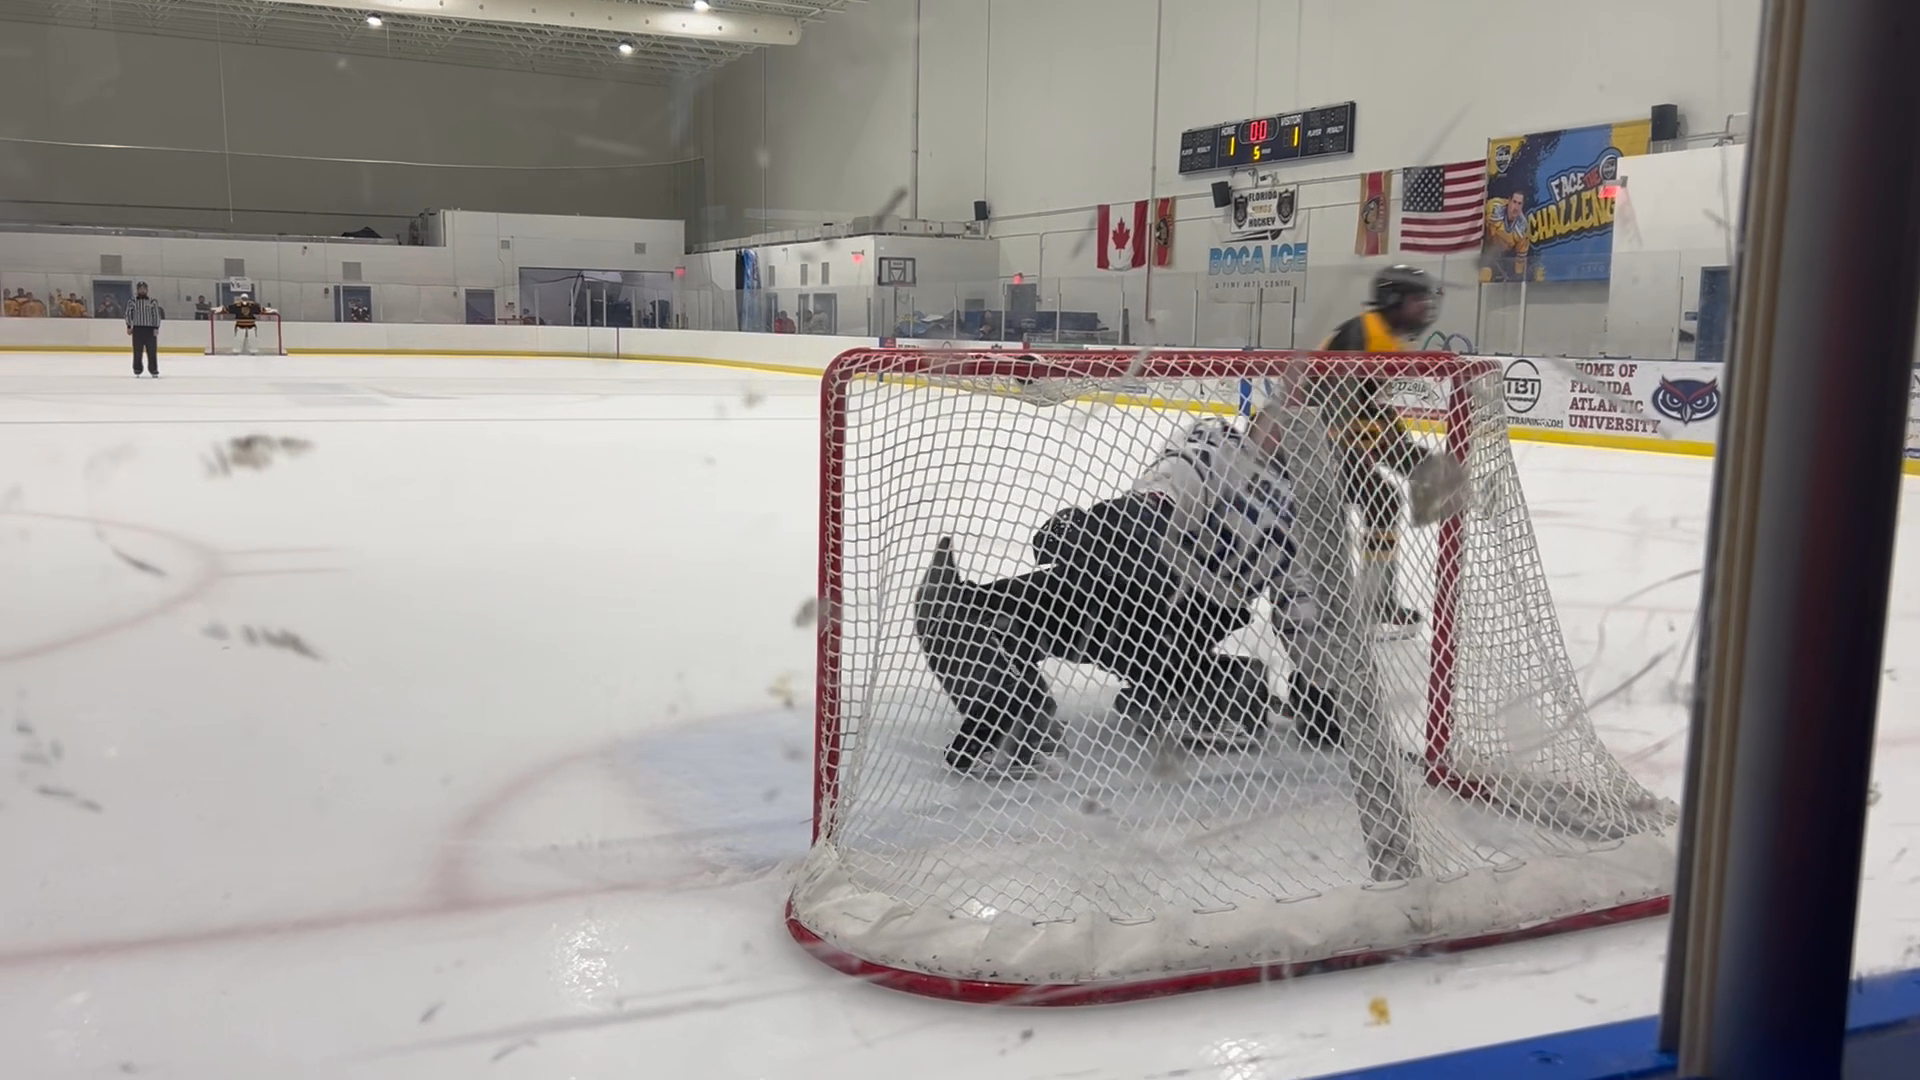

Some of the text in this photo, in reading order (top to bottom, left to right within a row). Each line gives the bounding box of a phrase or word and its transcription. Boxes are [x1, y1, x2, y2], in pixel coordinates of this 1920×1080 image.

[1282, 115, 1301, 126] VISITOR
[1221, 127, 1236, 136] HOME
[1294, 127, 1299, 146] 1
[1231, 137, 1235, 156] 1
[1254, 146, 1260, 159] 5
[1249, 191, 1277, 201] FLORIDA
[1551, 172, 1585, 202] FACE
[1249, 217, 1276, 227] HOCKEY
[1528, 189, 1615, 243] CHALLENG
[1209, 243, 1308, 275] BOCA ICE
[1575, 362, 1638, 378] HOME OF
[1568, 396, 1644, 414] ATLANTIC
[1568, 413, 1662, 434] UNIVERSITY
